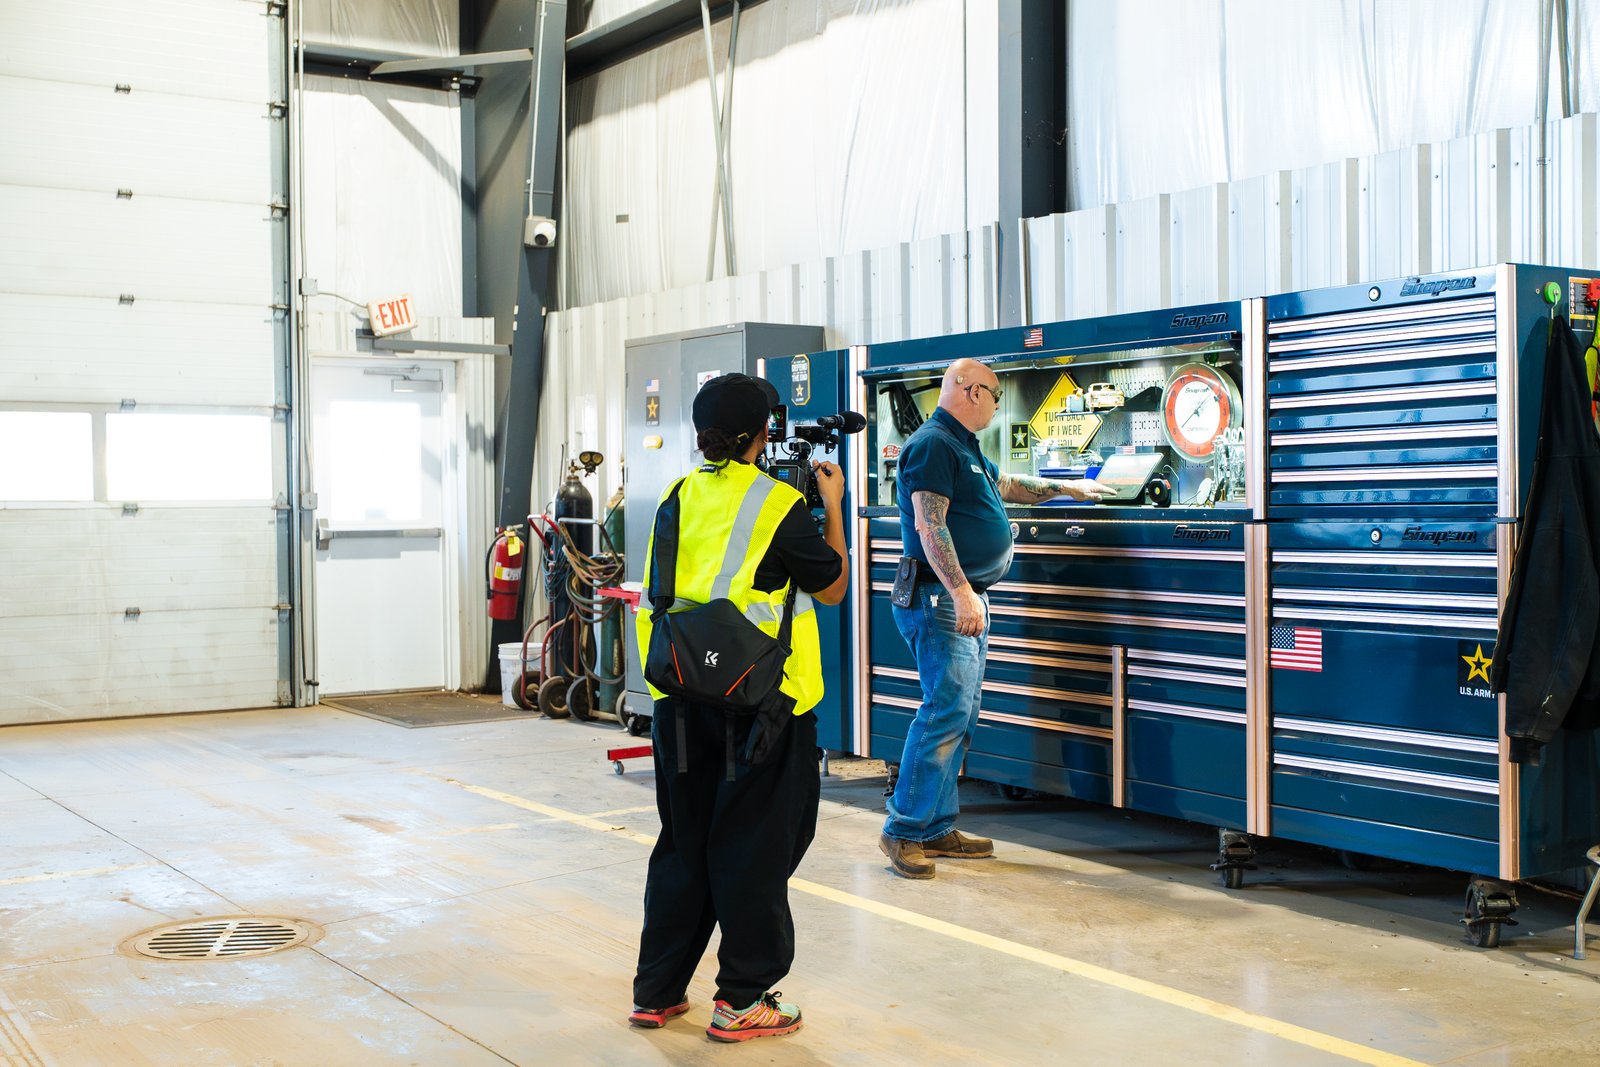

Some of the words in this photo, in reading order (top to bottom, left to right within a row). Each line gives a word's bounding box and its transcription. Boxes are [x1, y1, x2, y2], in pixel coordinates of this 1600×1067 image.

[378, 298, 411, 329] EXIT
[1048, 425, 1055, 436] IF
[1062, 424, 1082, 436] WERE
[1460, 686, 1473, 696] U.S.
